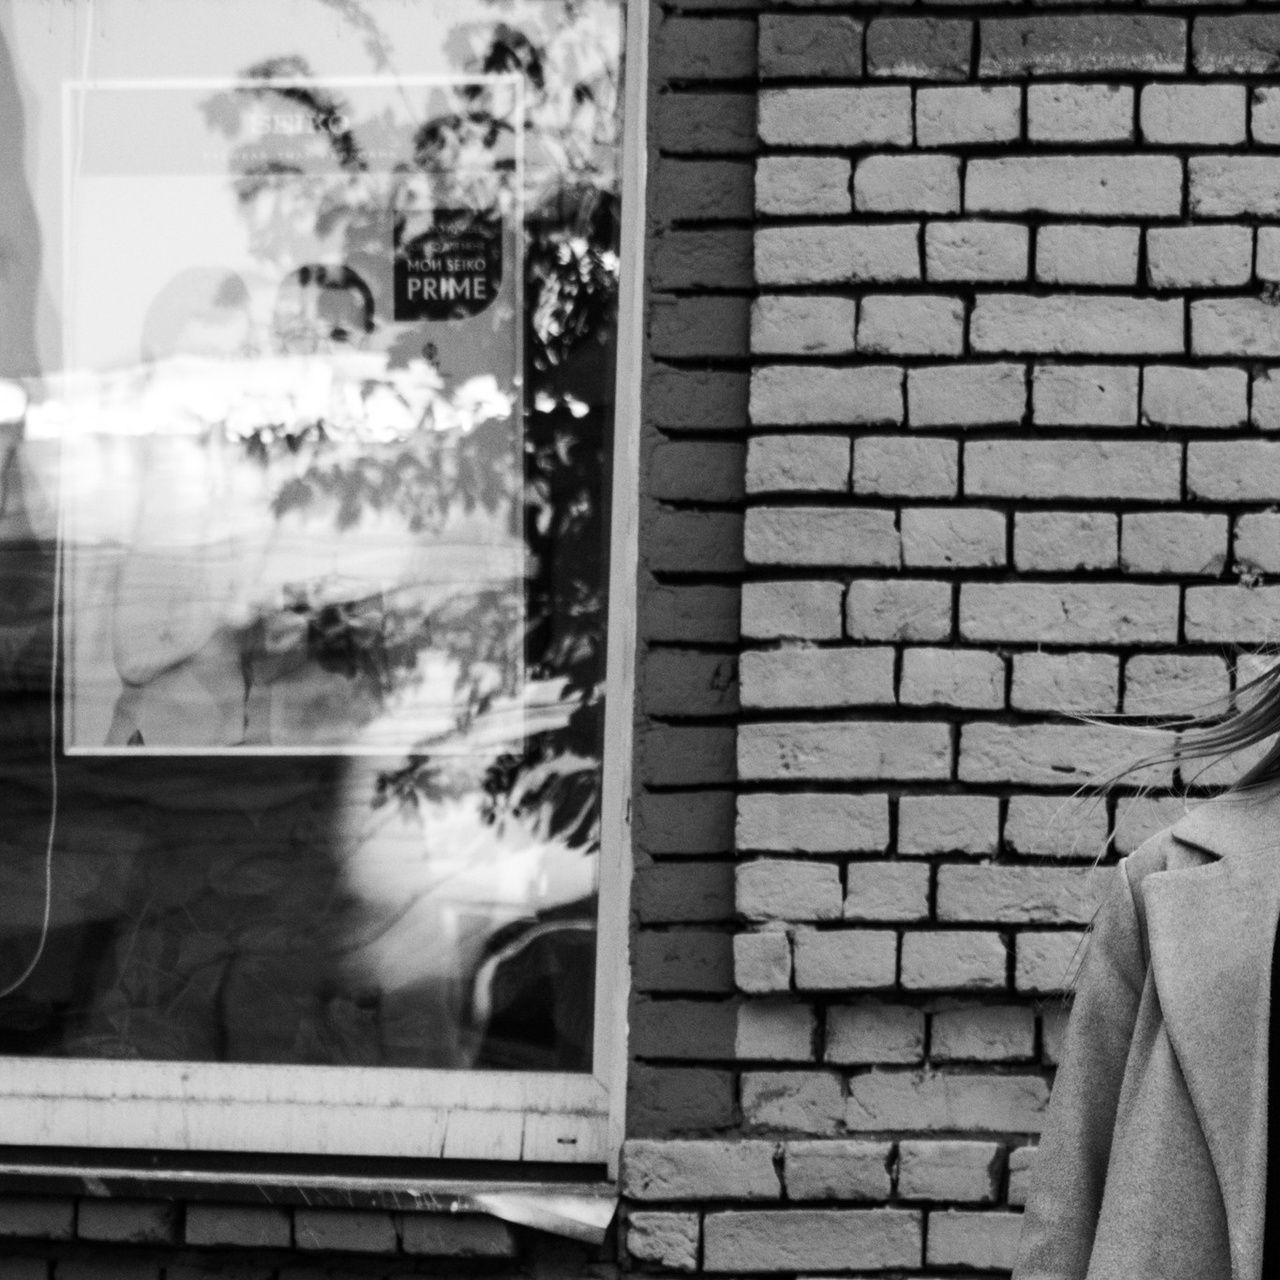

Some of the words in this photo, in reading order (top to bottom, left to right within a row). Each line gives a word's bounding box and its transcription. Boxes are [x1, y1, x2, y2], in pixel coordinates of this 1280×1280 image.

[250, 115, 350, 134] SEIKO
[446, 258, 487, 272] SEIKO
[407, 277, 487, 300] PRIME
